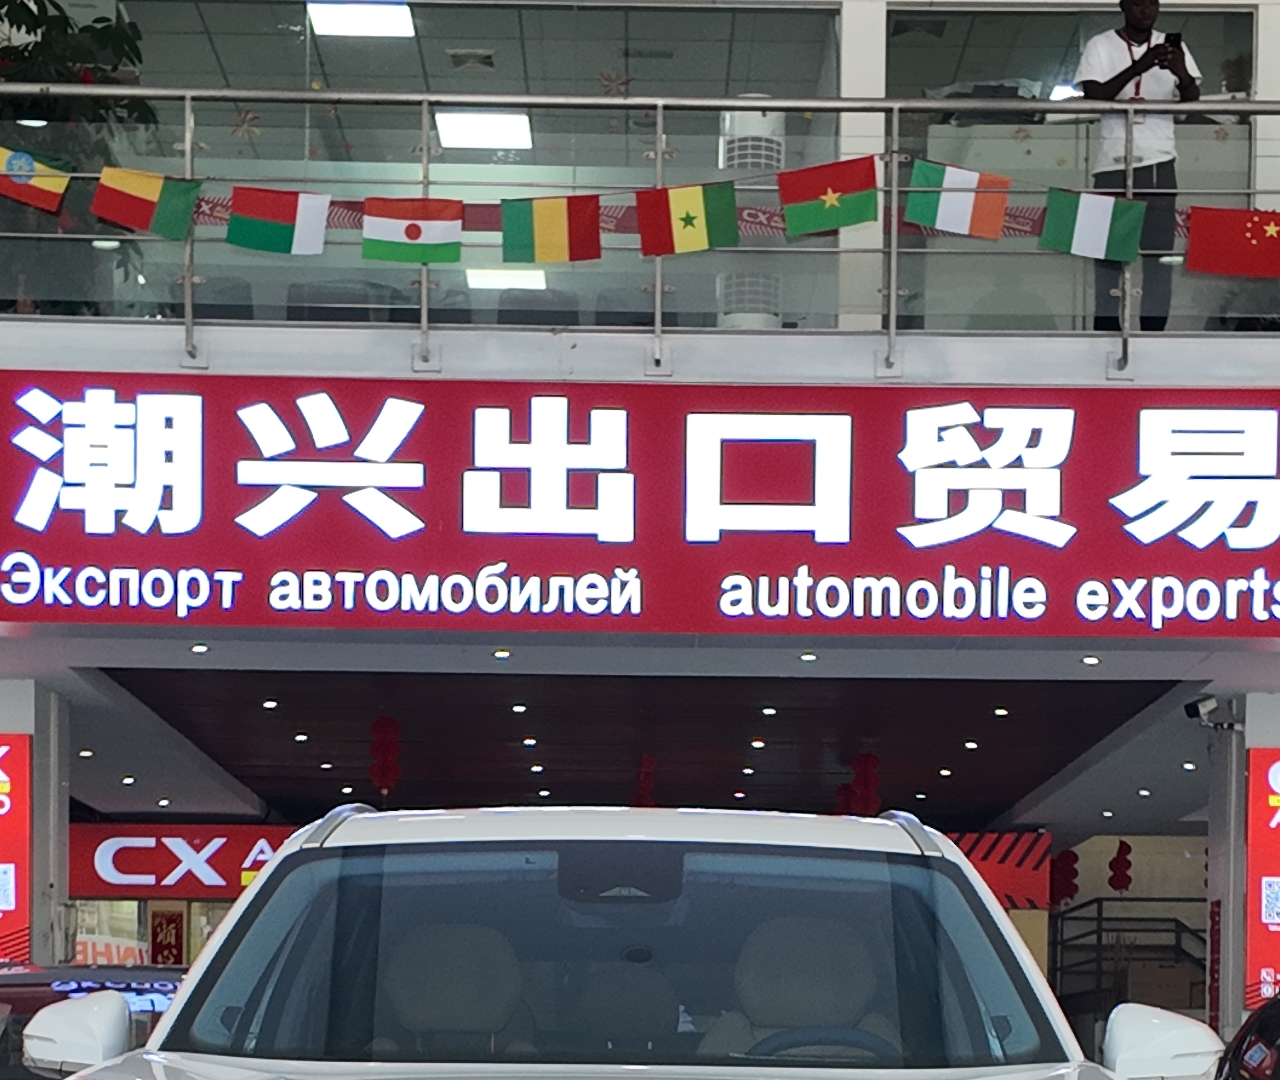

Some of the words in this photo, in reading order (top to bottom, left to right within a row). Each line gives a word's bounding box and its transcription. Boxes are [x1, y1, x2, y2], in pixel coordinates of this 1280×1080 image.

[0, 551, 243, 617] Экспорт
[268, 561, 641, 615] автомобилей
[719, 564, 1047, 620] automobile
[93, 836, 228, 886] CX
